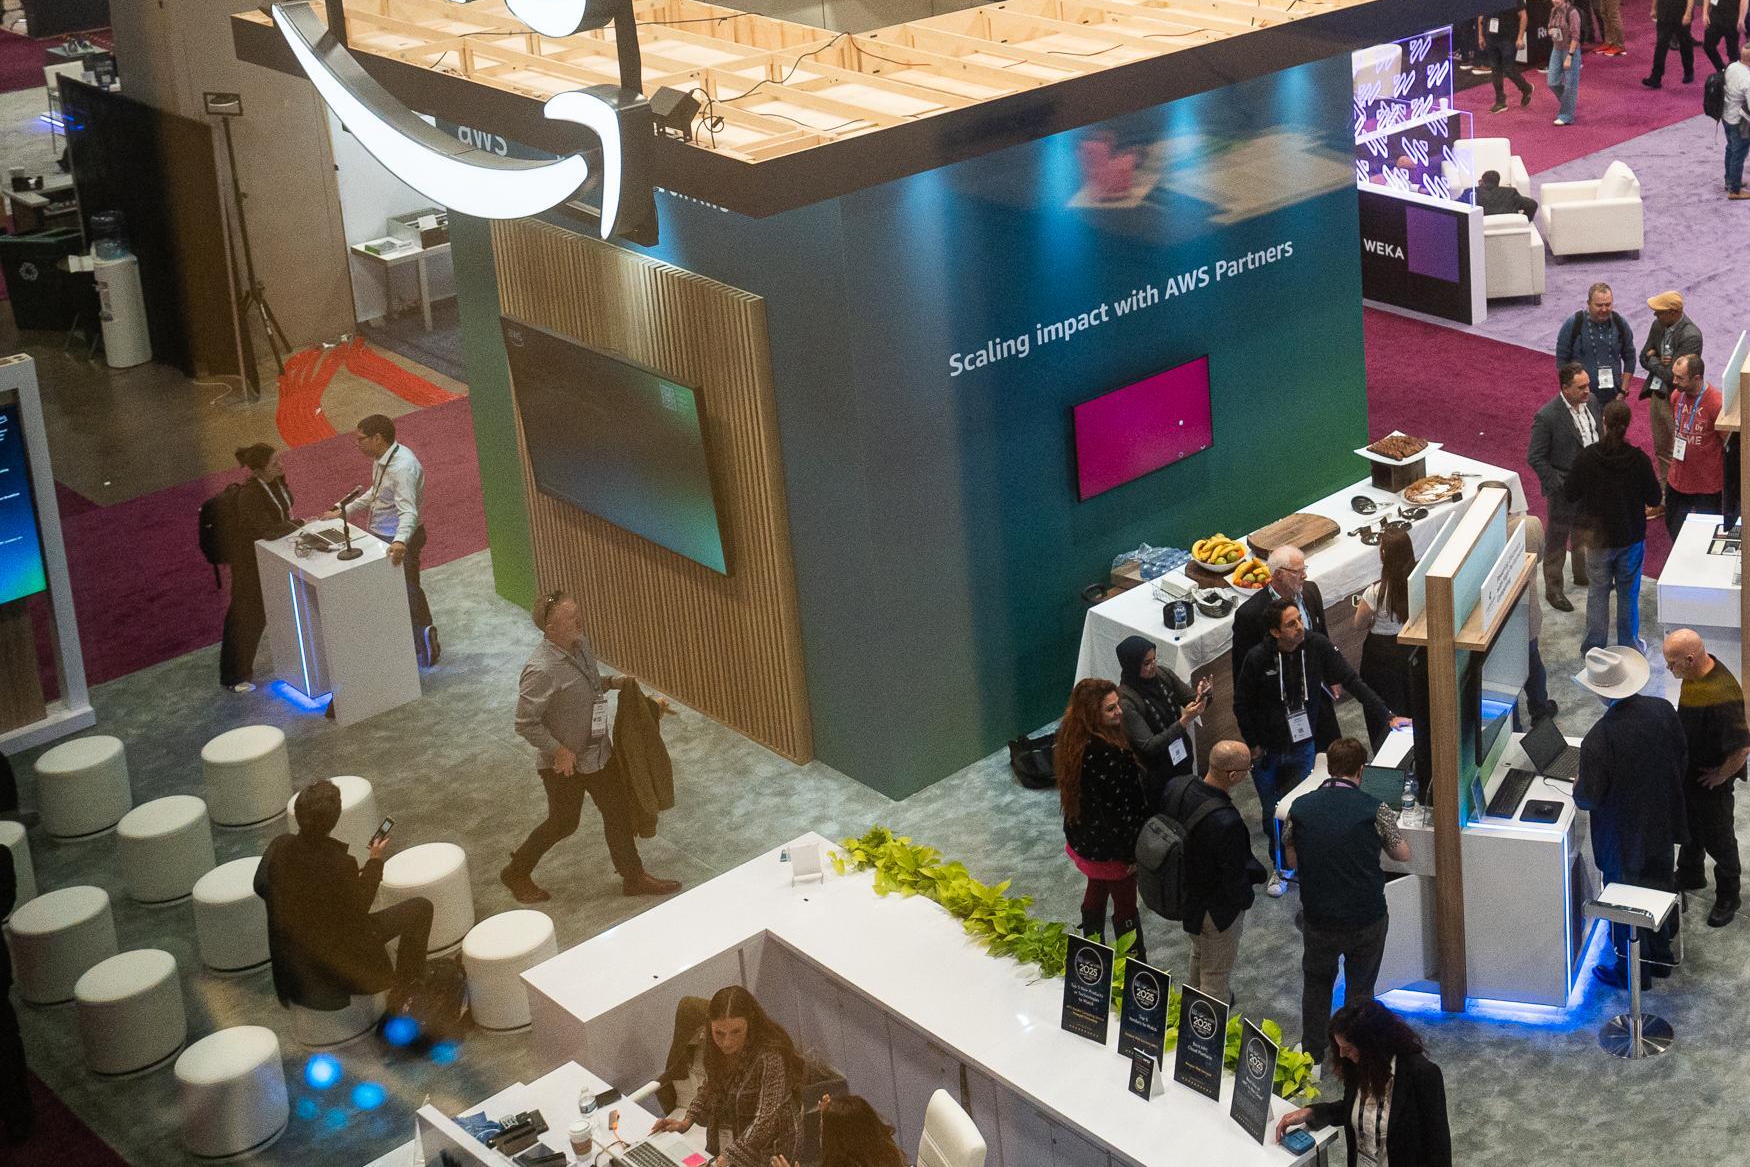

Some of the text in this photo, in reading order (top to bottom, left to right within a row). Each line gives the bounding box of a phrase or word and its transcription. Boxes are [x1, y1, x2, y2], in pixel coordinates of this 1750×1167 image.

[1363, 237, 1405, 261] WEKA
[948, 240, 1294, 377] Scaling impact with AWS Partners
[1079, 963, 1098, 977] 2025
[1136, 988, 1155, 1002] 2025
[1193, 1016, 1212, 1032] 2025
[1249, 1053, 1264, 1072] 2025
